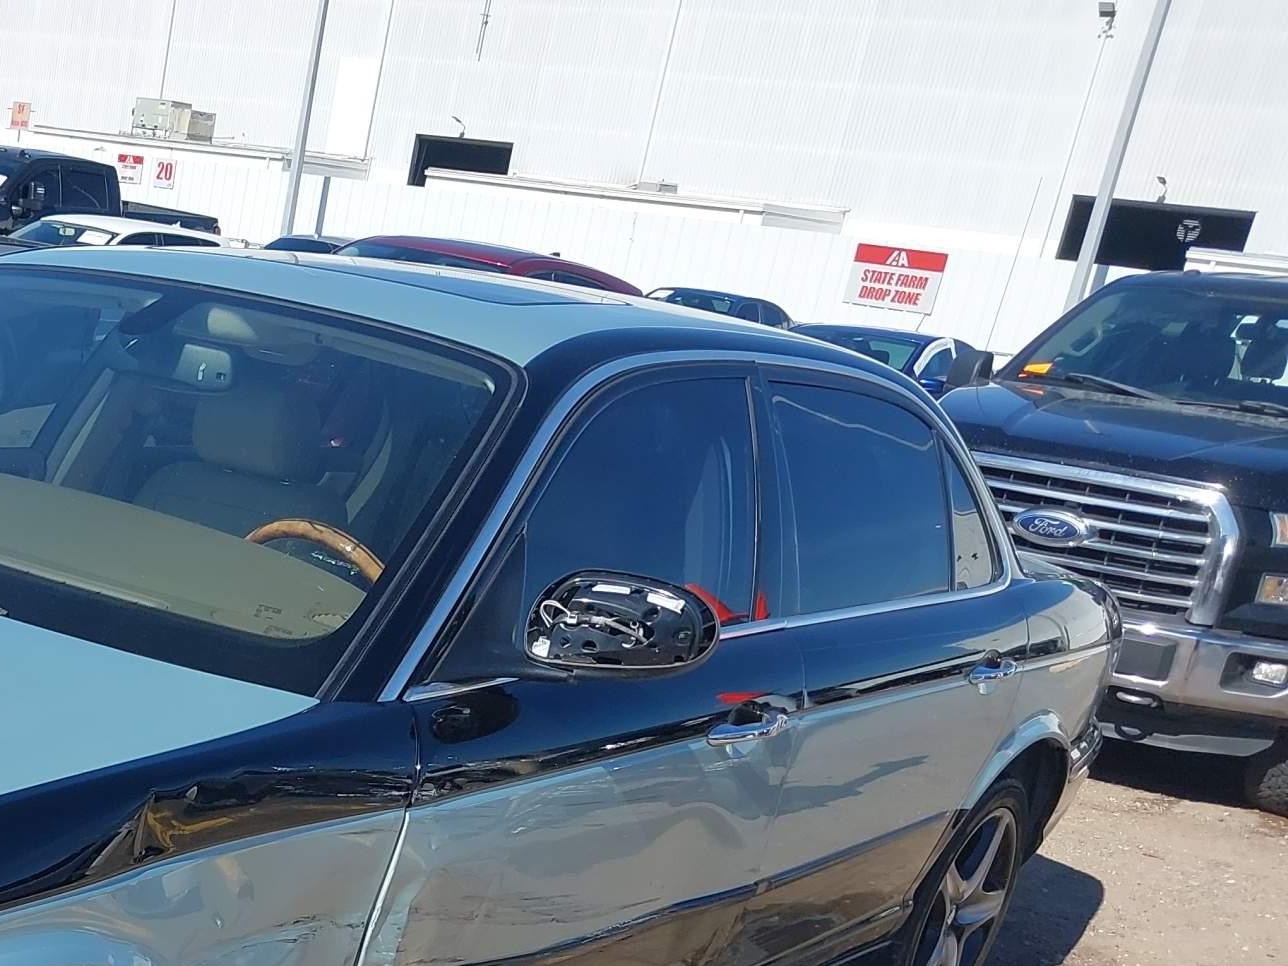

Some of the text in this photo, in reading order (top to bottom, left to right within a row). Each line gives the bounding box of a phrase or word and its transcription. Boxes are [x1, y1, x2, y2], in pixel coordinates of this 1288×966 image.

[156, 161, 173, 181] 20
[860, 268, 929, 291] STATE FARM
[857, 284, 922, 306] DROP ZONE
[1028, 517, 1069, 538] Ford
